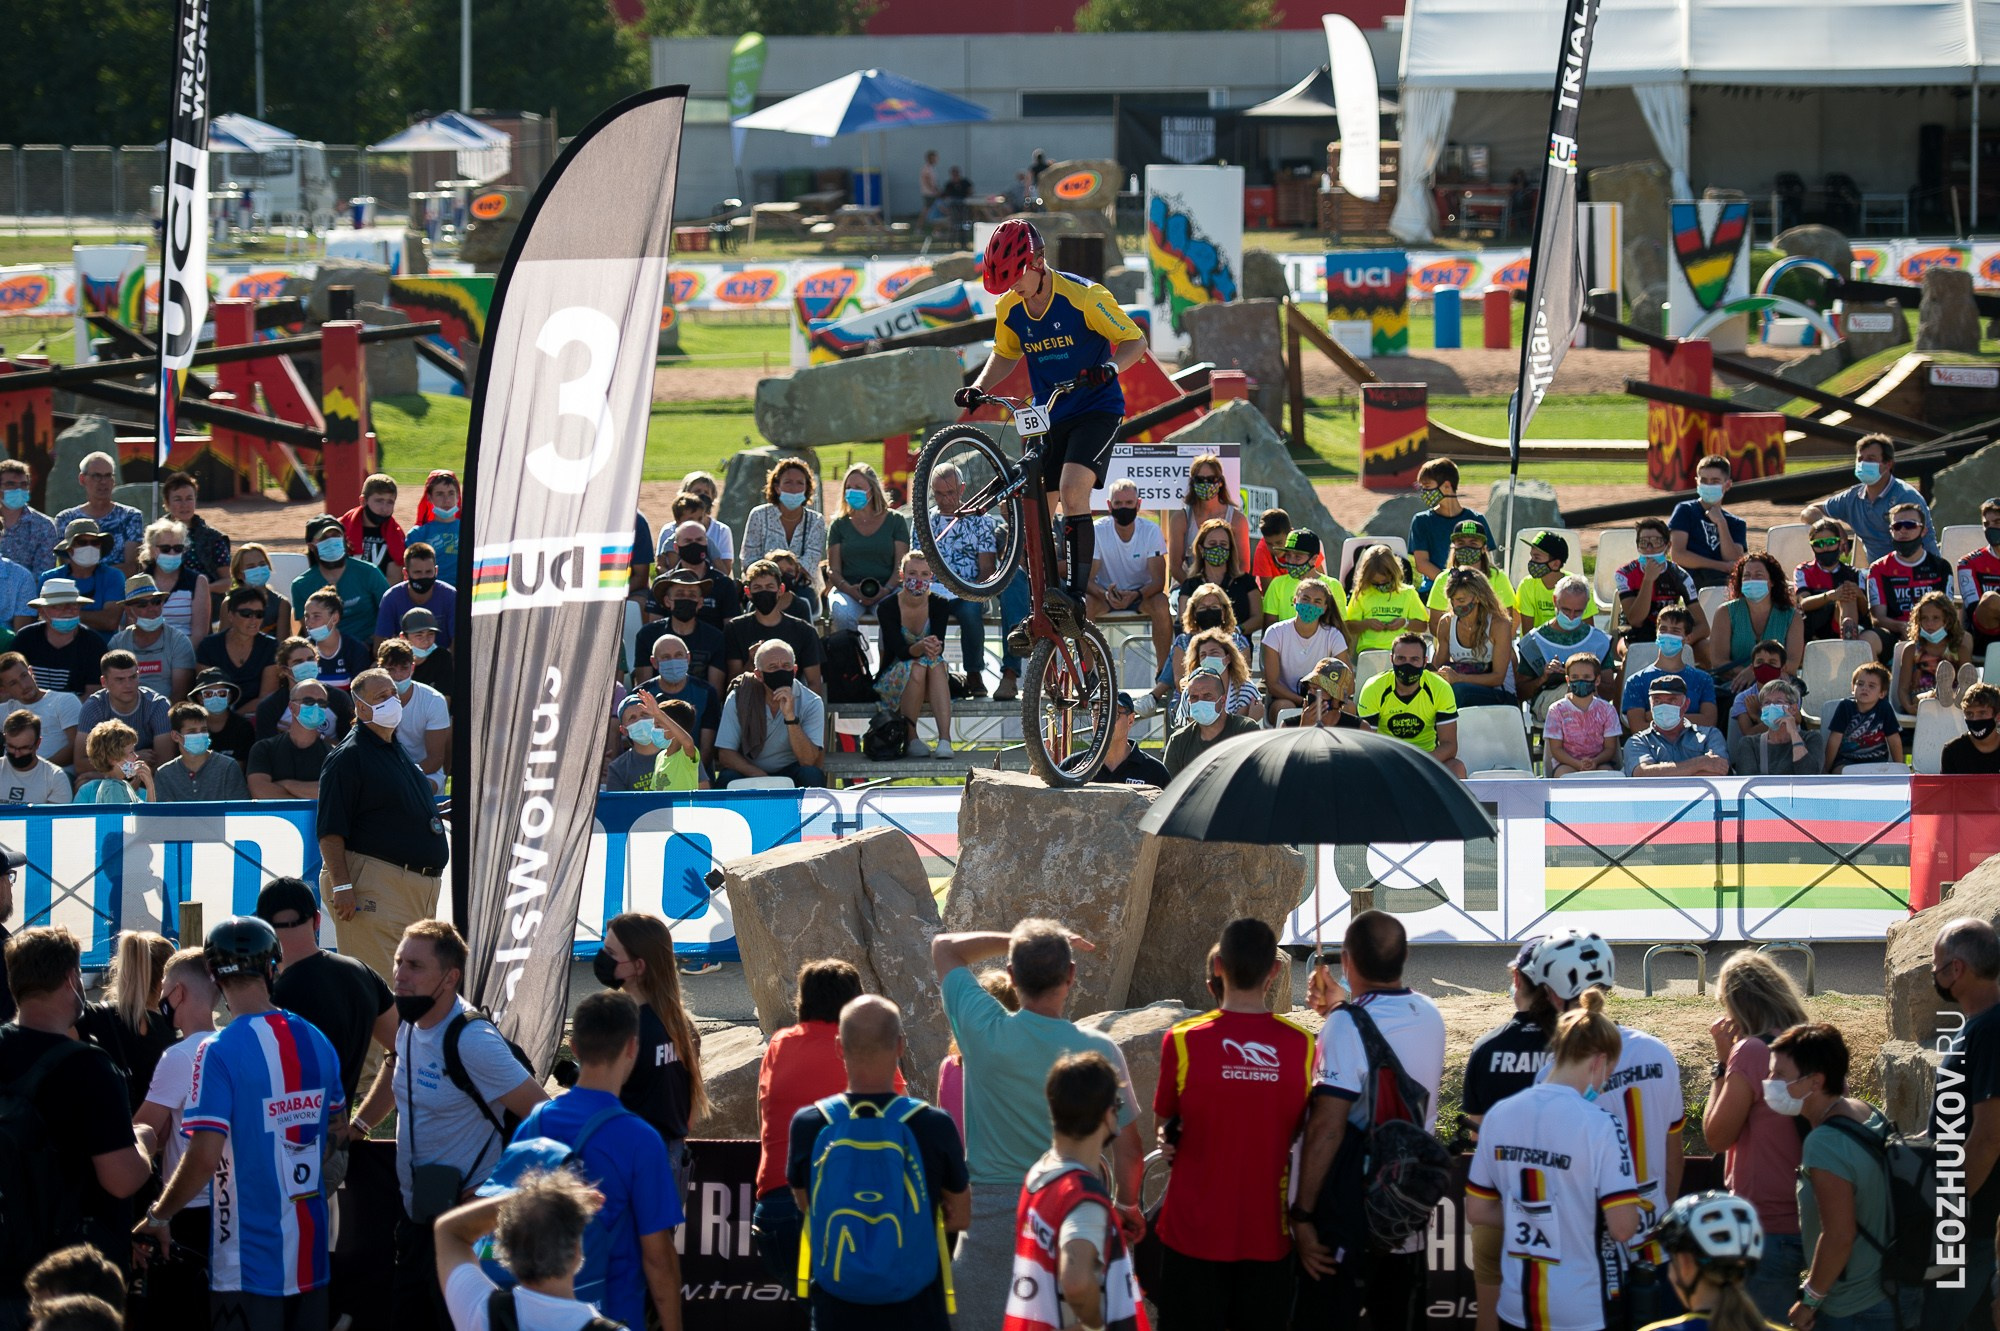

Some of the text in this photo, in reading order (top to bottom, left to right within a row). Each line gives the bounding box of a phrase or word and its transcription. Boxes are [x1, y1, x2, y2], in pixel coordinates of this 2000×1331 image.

[192, 0, 209, 120] WORL
[1558, 0, 1589, 110] TRIAL
[166, 161, 196, 357] UCI
[1343, 266, 1391, 288] UCI
[874, 309, 921, 339] UCI
[1096, 302, 1126, 331] postnord
[1024, 335, 1074, 353] SWEDEN
[1038, 352, 1069, 363] postnord
[525, 306, 620, 494] 3
[1024, 417, 1039, 429] 5B
[1114, 447, 1132, 455] UCI
[1127, 466, 1190, 478] RESERVE
[1138, 487, 1170, 499] ESTS
[511, 546, 585, 596] UCI
[191, 1042, 207, 1102] STRABAG
[1490, 1052, 1556, 1072] FRAN
[1222, 1070, 1279, 1082] CICLISMO
[269, 1094, 322, 1117] STRABAG
[1601, 1108, 1631, 1177] ŠKOD
[1500, 1145, 1572, 1171] DEUTSCHLAND
[1515, 1221, 1551, 1248] 3A
